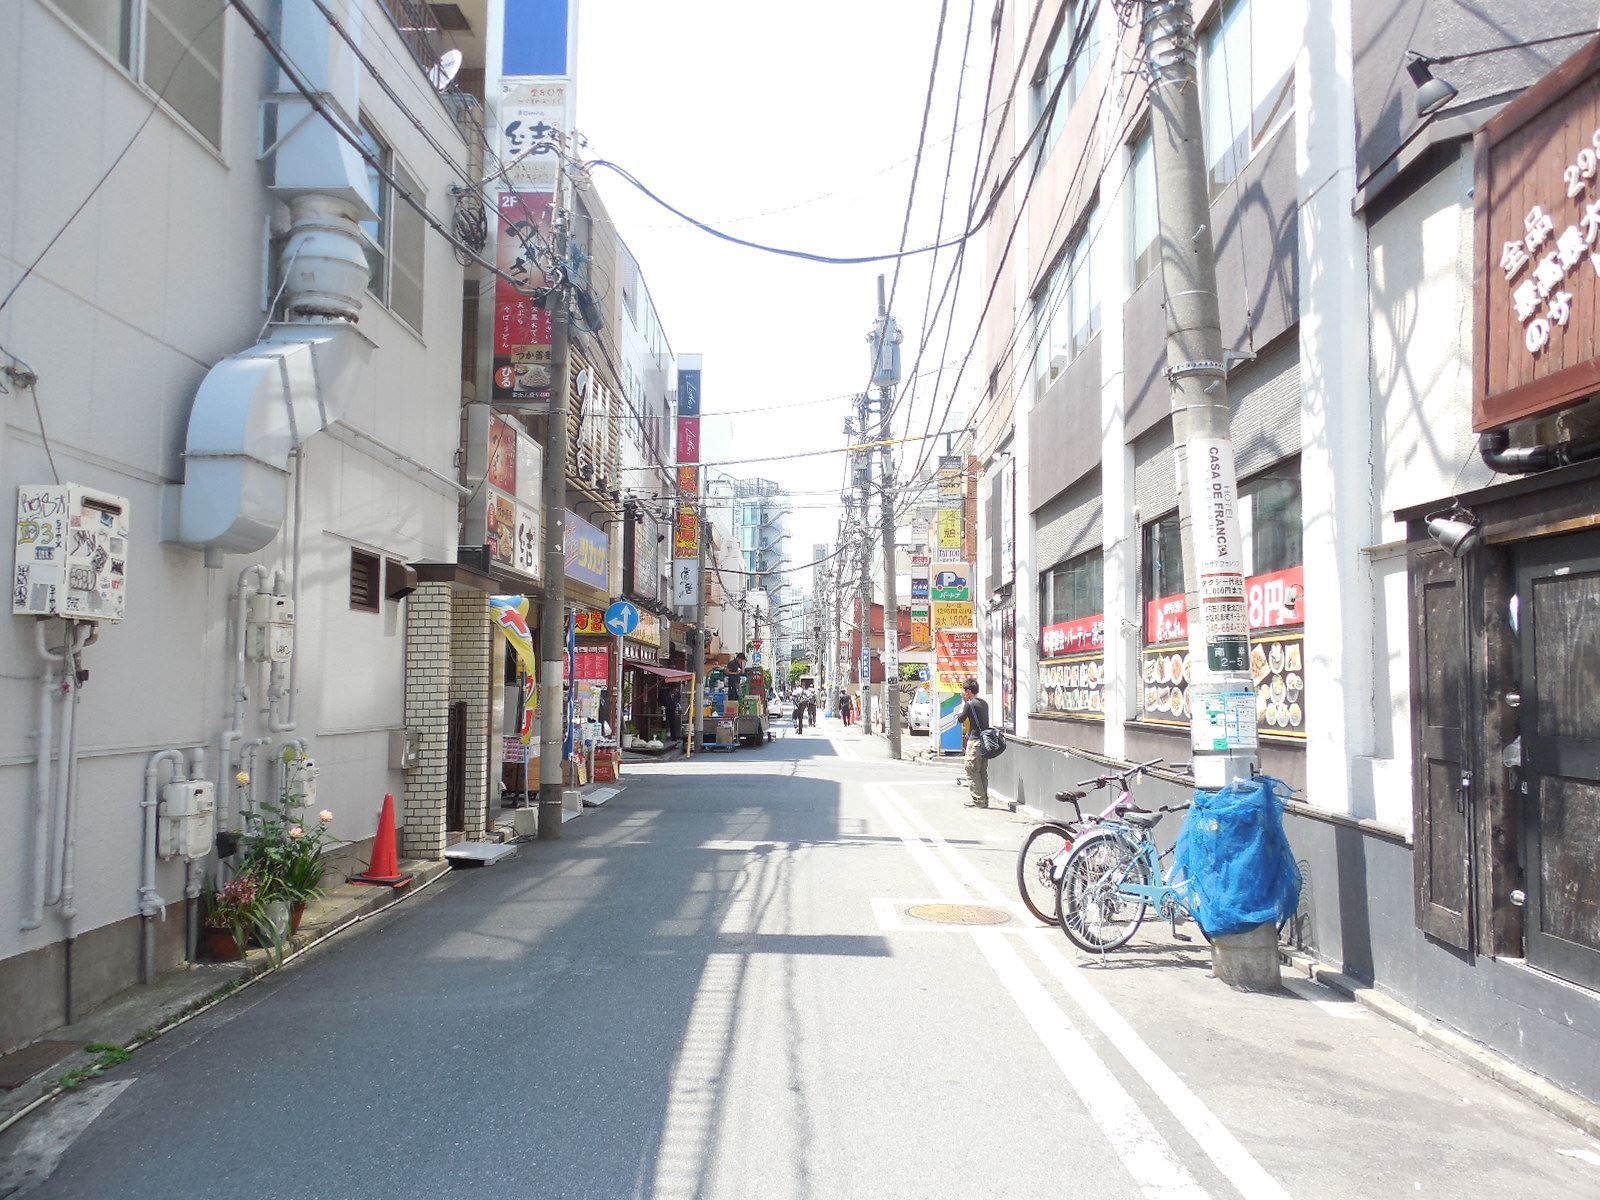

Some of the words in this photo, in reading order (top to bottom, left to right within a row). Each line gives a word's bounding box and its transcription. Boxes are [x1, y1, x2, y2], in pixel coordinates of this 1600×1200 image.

[1500, 206, 1553, 282] 全品
[1209, 447, 1221, 479] CASA
[1212, 483, 1223, 499] DE
[1223, 485, 1233, 520] HOTEL
[1214, 502, 1228, 557] FRANCIA
[1221, 657, 1243, 667] 2-5
